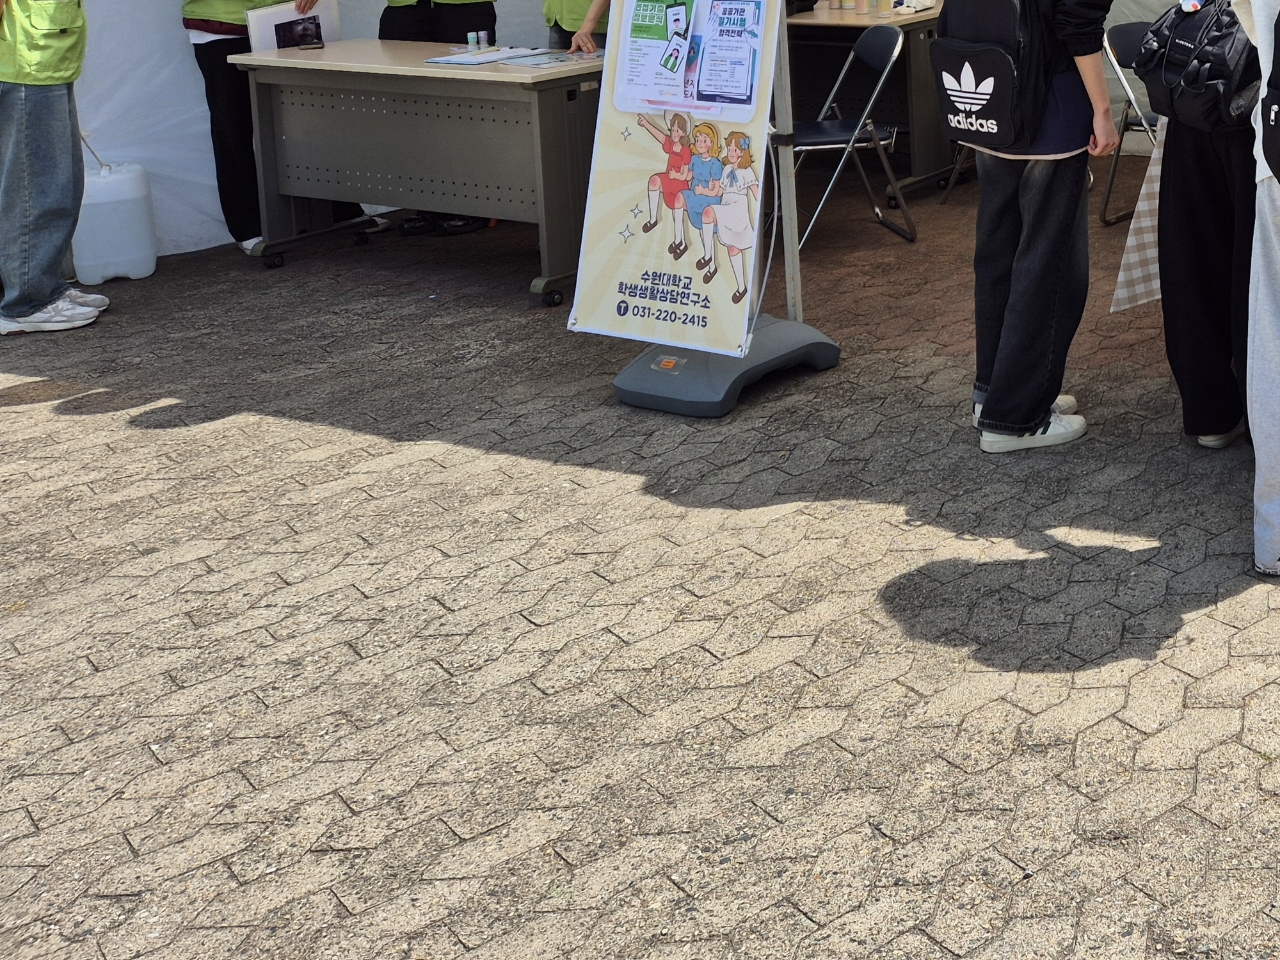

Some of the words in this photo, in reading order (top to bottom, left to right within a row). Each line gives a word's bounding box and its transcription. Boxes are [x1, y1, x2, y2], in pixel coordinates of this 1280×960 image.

[948, 113, 998, 133] adidas
[640, 270, 693, 290] 수원대학교
[617, 281, 711, 309] 학생생활상담연구소
[632, 305, 708, 328] 031-220-2415
